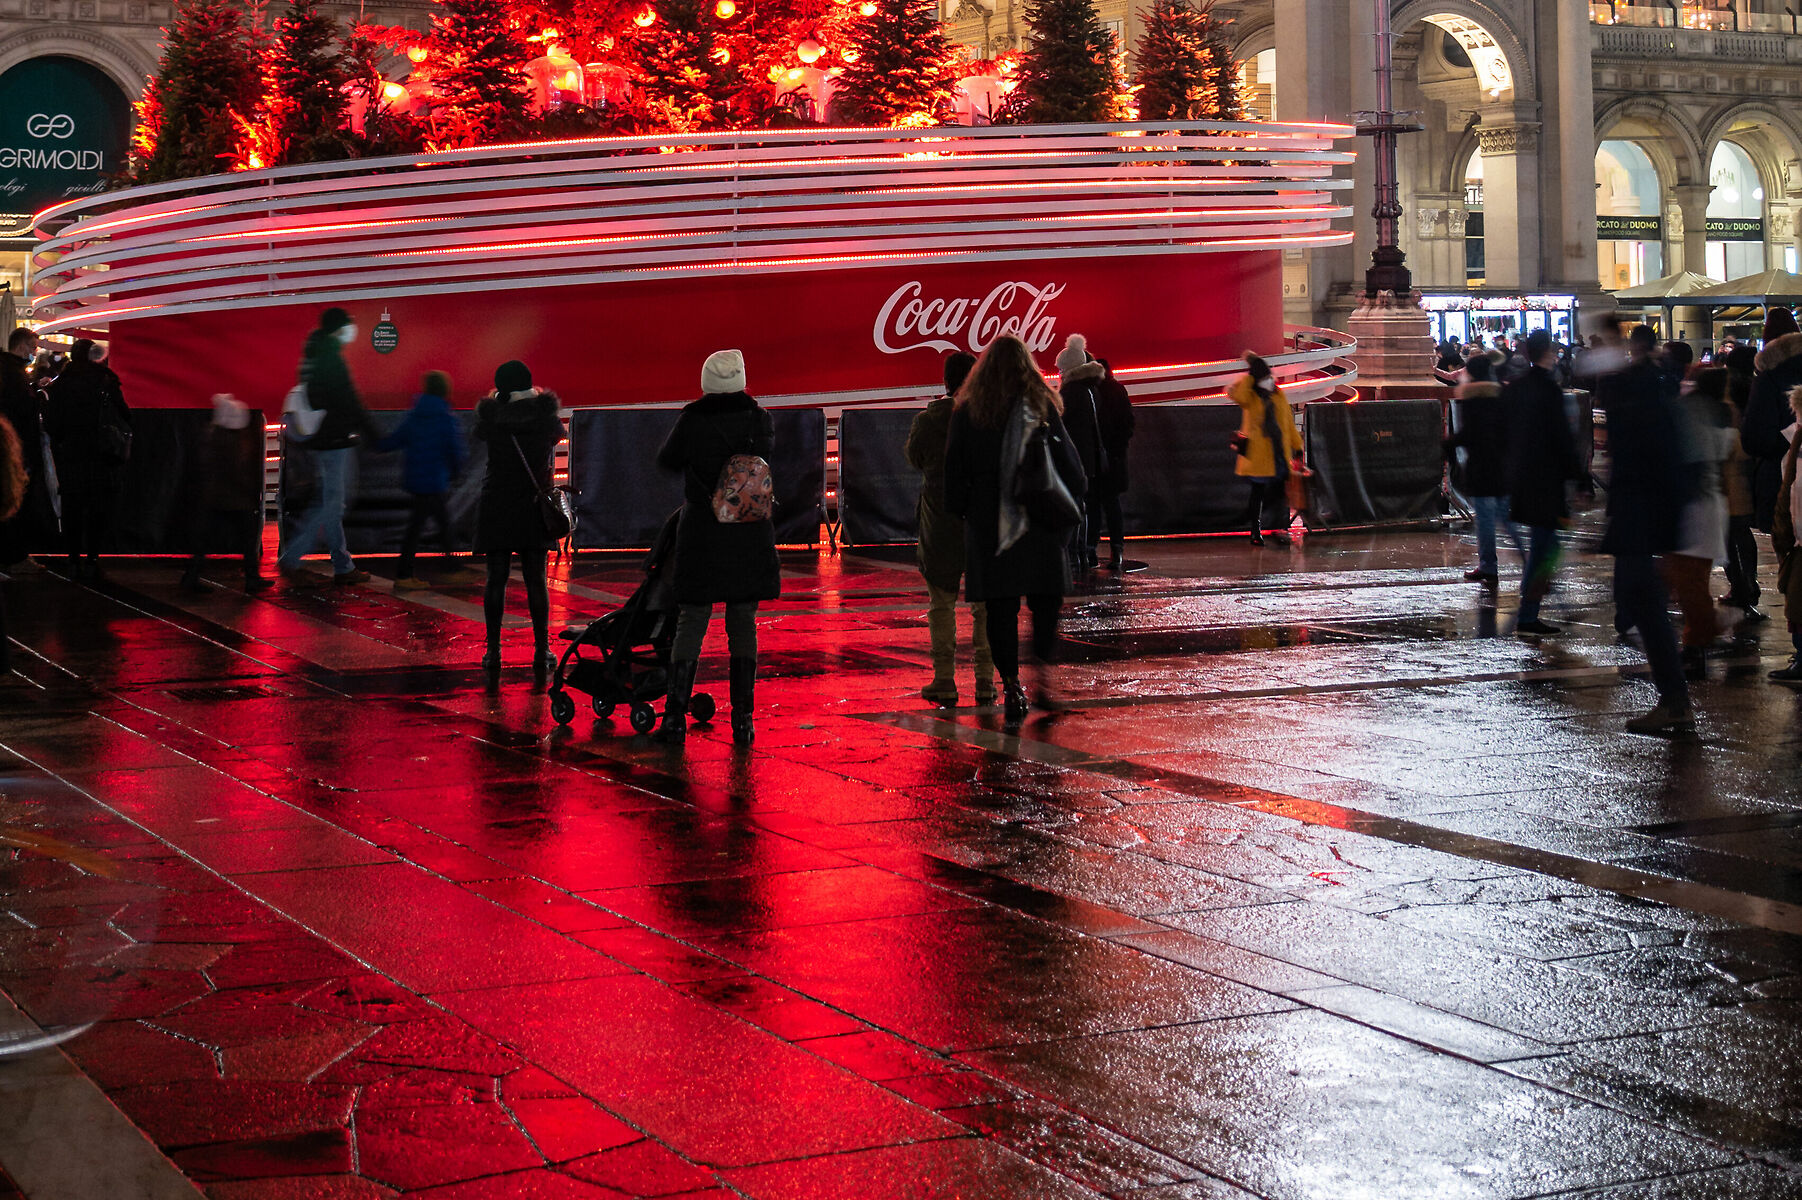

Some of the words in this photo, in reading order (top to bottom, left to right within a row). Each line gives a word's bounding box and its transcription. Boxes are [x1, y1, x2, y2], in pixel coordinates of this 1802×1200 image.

[0, 147, 104, 170] GRIMOLDI
[1597, 220, 1620, 229] RCATO
[1629, 221, 1658, 229] DUOMO
[1705, 222, 1724, 230] CATO
[1733, 222, 1761, 231] DUOMO
[873, 280, 1067, 354] Coca-Cola
